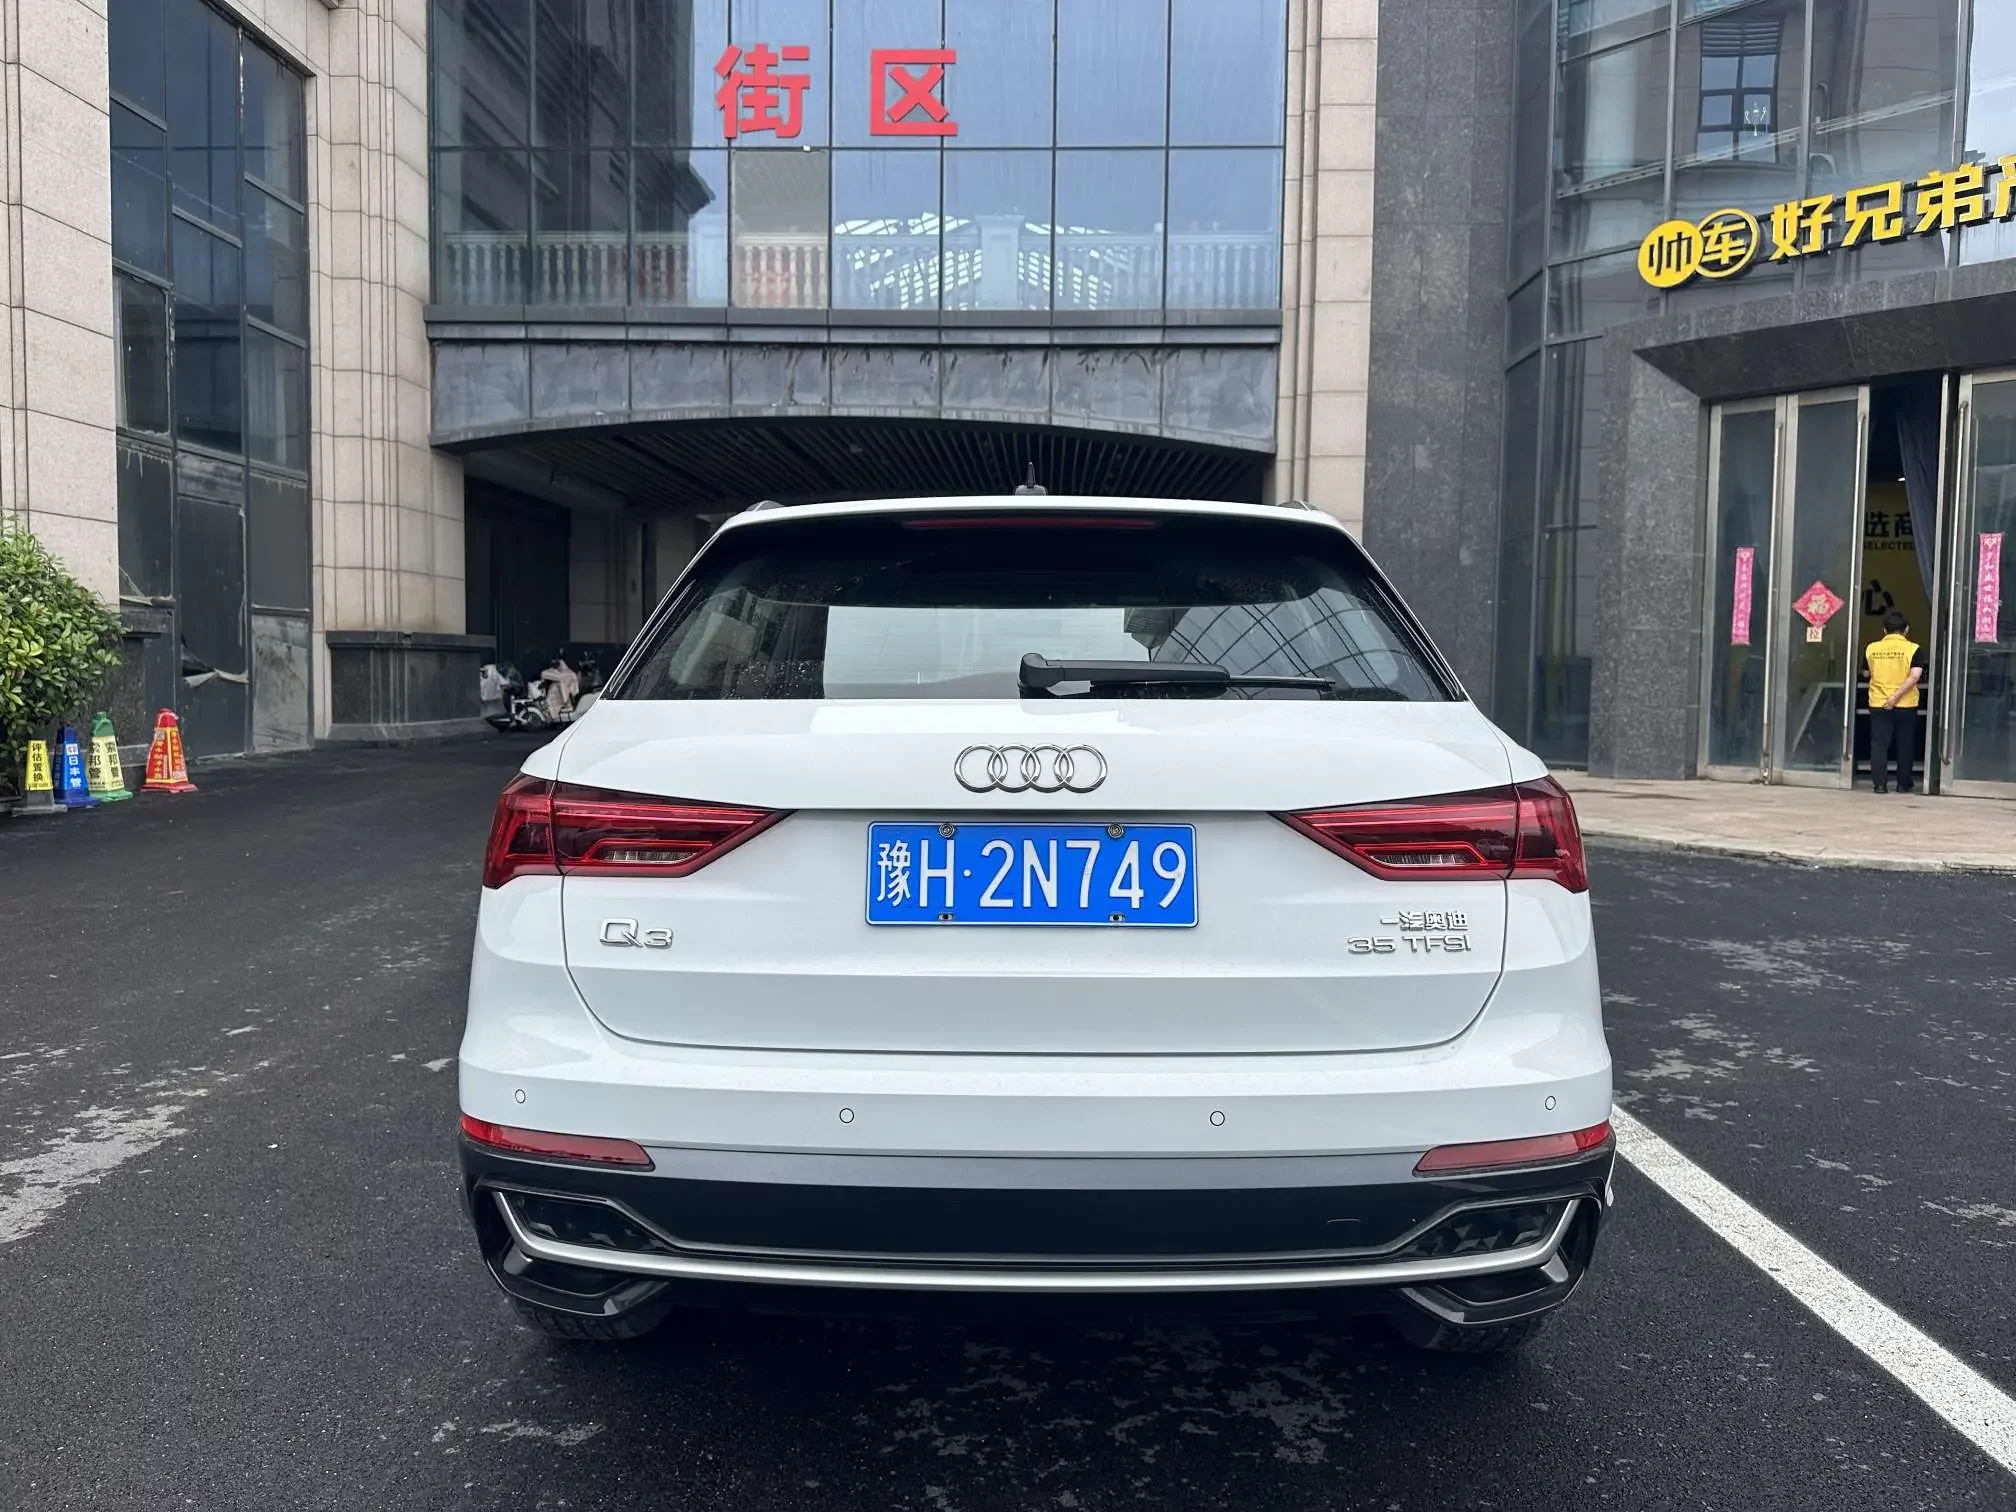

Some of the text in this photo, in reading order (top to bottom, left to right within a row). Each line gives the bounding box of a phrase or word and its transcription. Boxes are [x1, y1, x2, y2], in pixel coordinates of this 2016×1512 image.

[714, 43, 958, 139] 街区
[32, 743, 43, 782] 评估置换
[600, 917, 674, 949] Q3
[1380, 910, 1468, 932] 一汽奥迪
[1347, 934, 1472, 955] 35 TFSI
